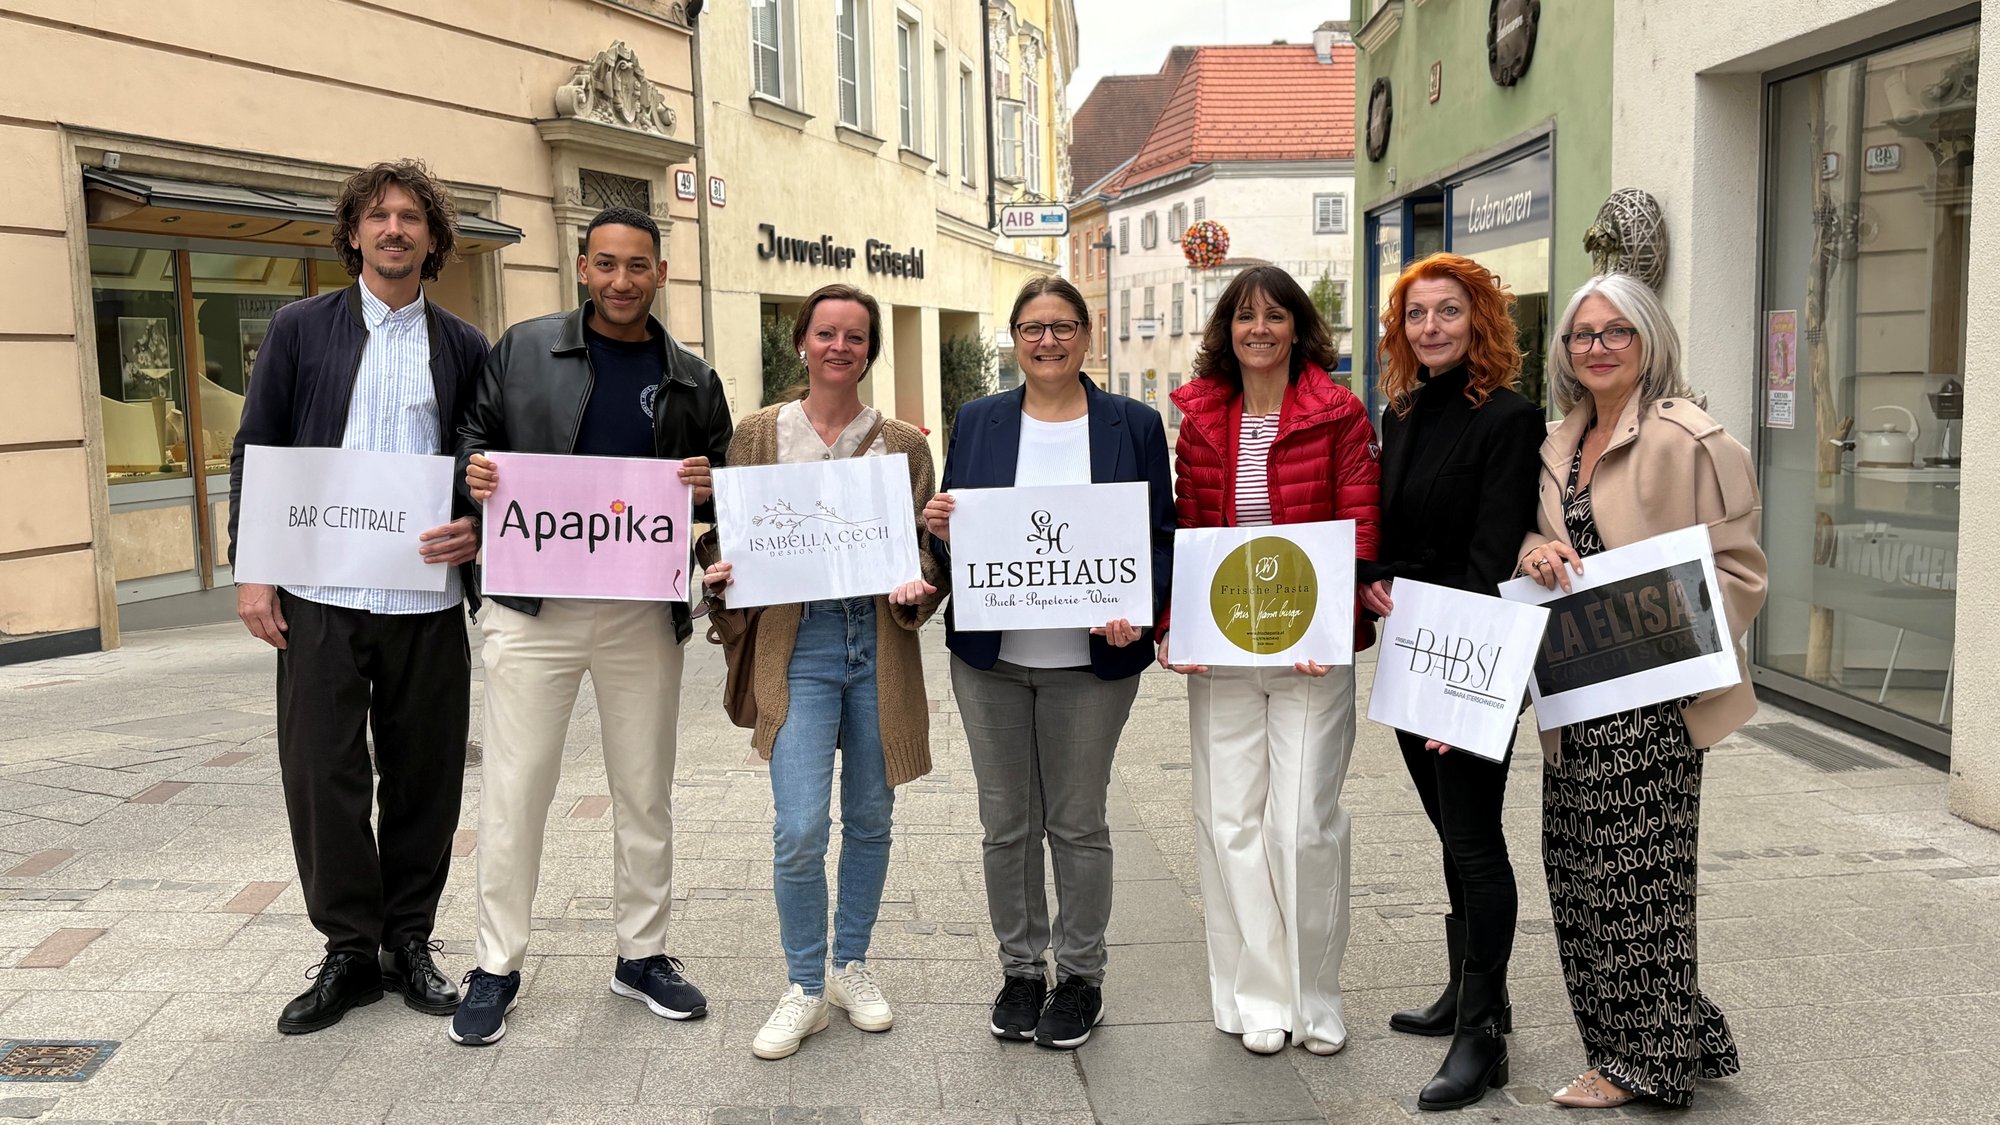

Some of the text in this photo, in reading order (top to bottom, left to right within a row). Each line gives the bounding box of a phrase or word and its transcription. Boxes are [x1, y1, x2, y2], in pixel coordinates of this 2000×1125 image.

[681, 174, 691, 190] 49
[1006, 211, 1034, 227] AIB
[1467, 190, 1533, 234] Lederwaren
[757, 222, 925, 280] Juwelier Göschl
[288, 505, 407, 534] BAR CENTRALE
[499, 499, 675, 555] Apapika
[749, 525, 889, 552] ISABELLA CECH
[967, 557, 1138, 589] LESEHAUS
[985, 592, 1017, 608] Buch
[1221, 583, 1310, 595] Frische Pasta
[1540, 578, 1698, 664] LA ELISA
[1408, 627, 1503, 692] BABSI
[1636, 631, 1694, 664] STOR
[1443, 687, 1467, 701] BARBARA
